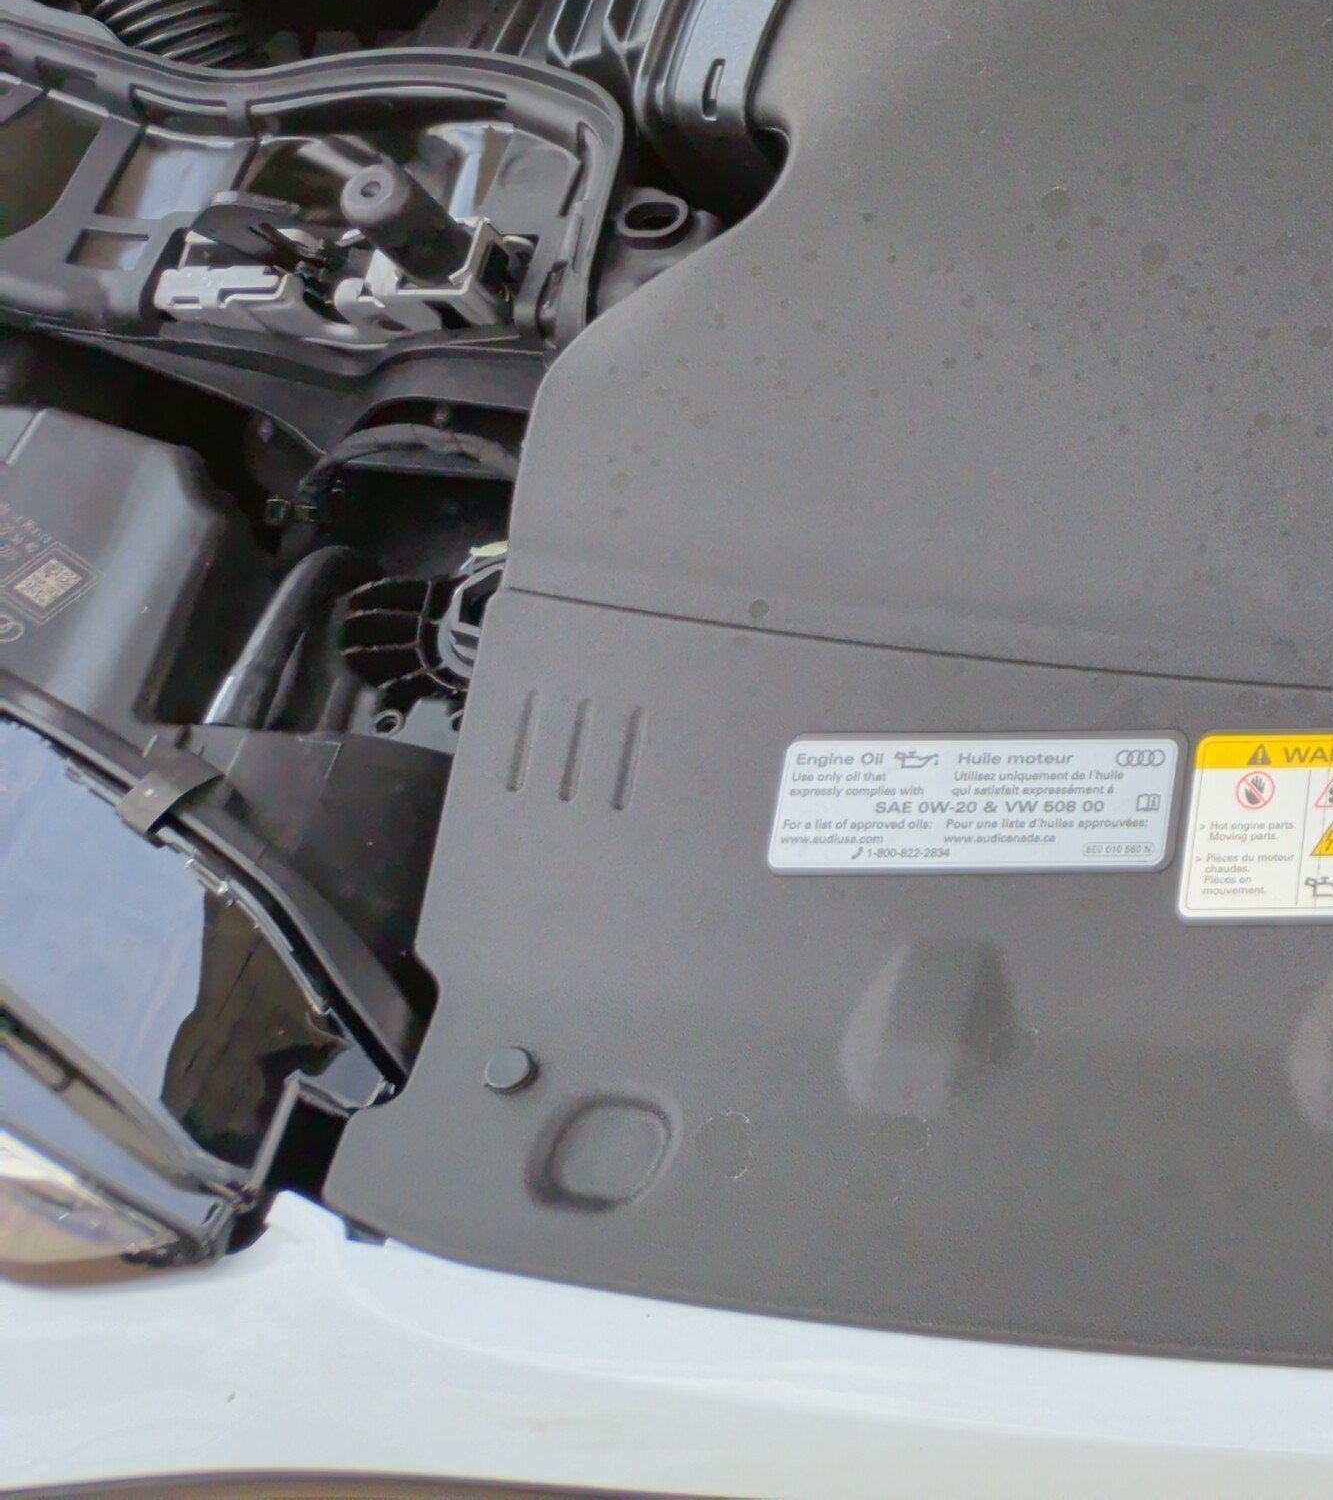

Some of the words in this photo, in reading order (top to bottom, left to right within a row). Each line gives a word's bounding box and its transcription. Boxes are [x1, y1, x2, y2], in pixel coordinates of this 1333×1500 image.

[796, 753, 855, 767] Engine
[860, 753, 884, 765] Oil
[957, 752, 1002, 765] Huile
[1007, 753, 1074, 765] moteur
[791, 772, 814, 782] Use
[817, 772, 844, 785] only
[845, 772, 861, 782] oil
[863, 772, 887, 782] that
[954, 771, 995, 781] Utilisez
[999, 771, 1068, 783] uniquement
[1071, 771, 1086, 780] de
[789, 785, 843, 798] expressly
[845, 786, 897, 798] complies
[900, 785, 924, 796] with
[951, 786, 971, 798] qui
[974, 785, 1019, 795] satisfait
[1022, 785, 1104, 797] expressément
[875, 801, 912, 813] SAE
[918, 801, 977, 813] 0W-20
[983, 801, 997, 813] &
[1004, 801, 1039, 812] VW
[1043, 801, 1077, 812] 508
[1083, 800, 1105, 812] 00
[783, 819, 802, 830] For
[815, 819, 832, 829] list
[835, 819, 848, 829] of
[850, 819, 905, 831] approved
[946, 819, 972, 829] Pour
[976, 821, 998, 829] une
[1001, 818, 1025, 829] liste
[1210, 821, 1229, 831] Hot
[1231, 822, 1265, 832] engine
[780, 834, 884, 844] www.audiusa.com
[943, 833, 1056, 843] www.audicanada.ca
[1209, 832, 1247, 843] Moving
[867, 847, 951, 858] 1-800-822-2834
[1241, 852, 1255, 862] du
[1258, 853, 1294, 862] moteur
[1239, 876, 1252, 884] en
